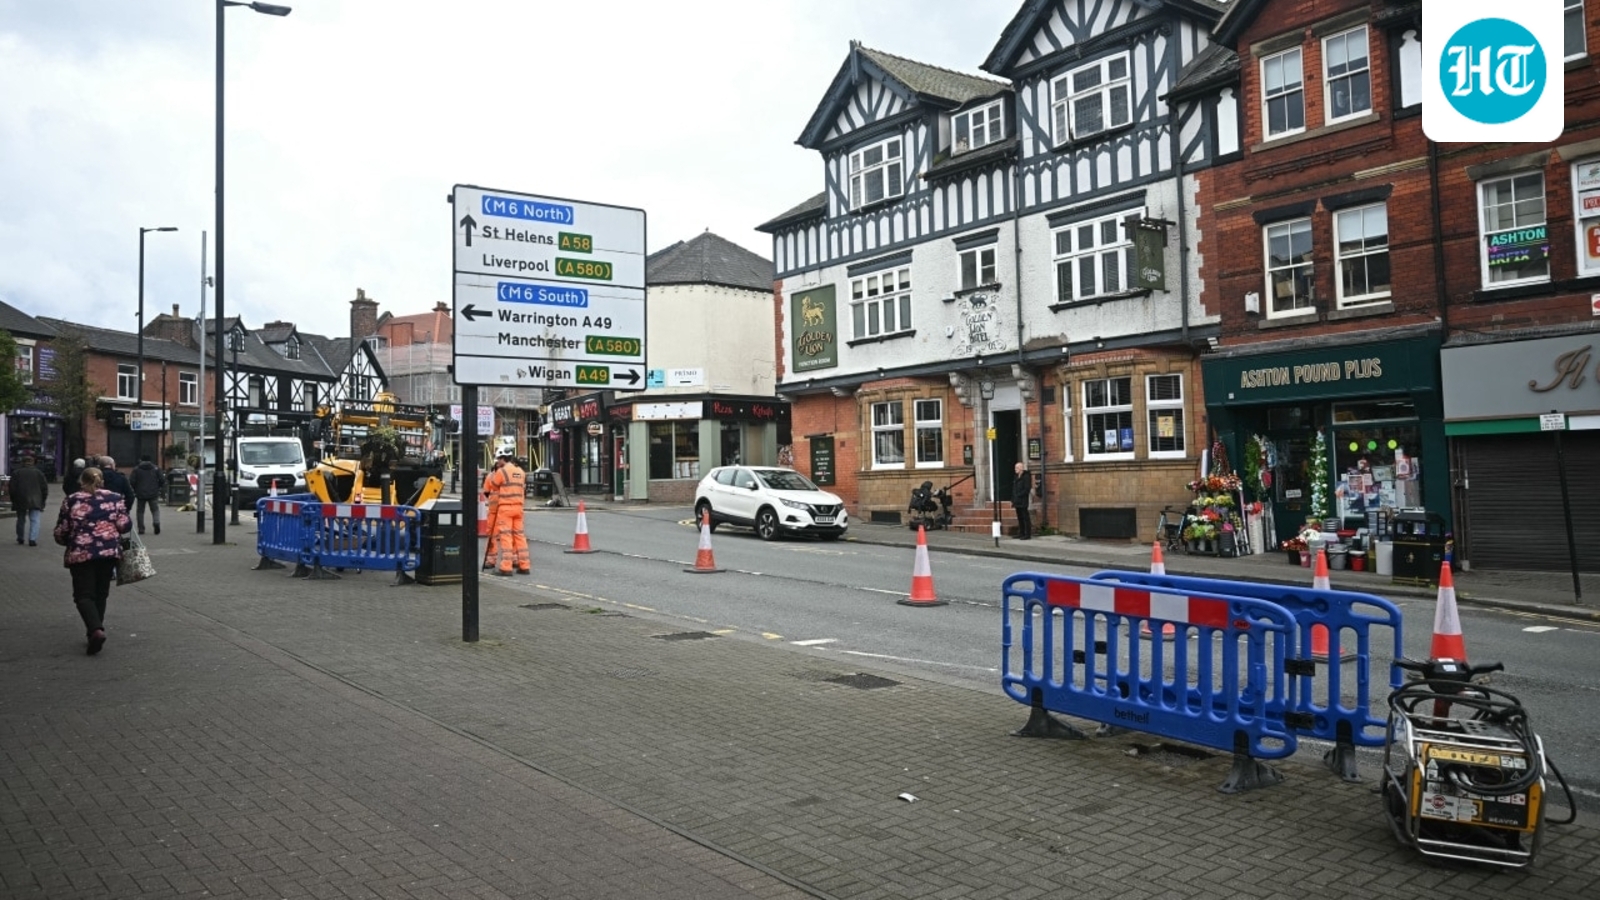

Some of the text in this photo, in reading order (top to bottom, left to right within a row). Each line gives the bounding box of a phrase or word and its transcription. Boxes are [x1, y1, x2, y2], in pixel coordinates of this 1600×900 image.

[523, 202, 573, 223] North)
[482, 225, 591, 251] St Helens A58
[1491, 226, 1547, 247] ASHTON
[482, 254, 612, 279] Liverpool (A580)
[538, 289, 587, 307] South)
[497, 309, 613, 330] Warrington A49
[498, 332, 640, 355] Manchester (A580)
[796, 331, 833, 356] GOLDEN
[805, 342, 825, 356] LION
[528, 365, 609, 382] Wigan A49
[1240, 357, 1383, 388] ASHTON POUND PLUS
[1113, 706, 1150, 725] bethell
